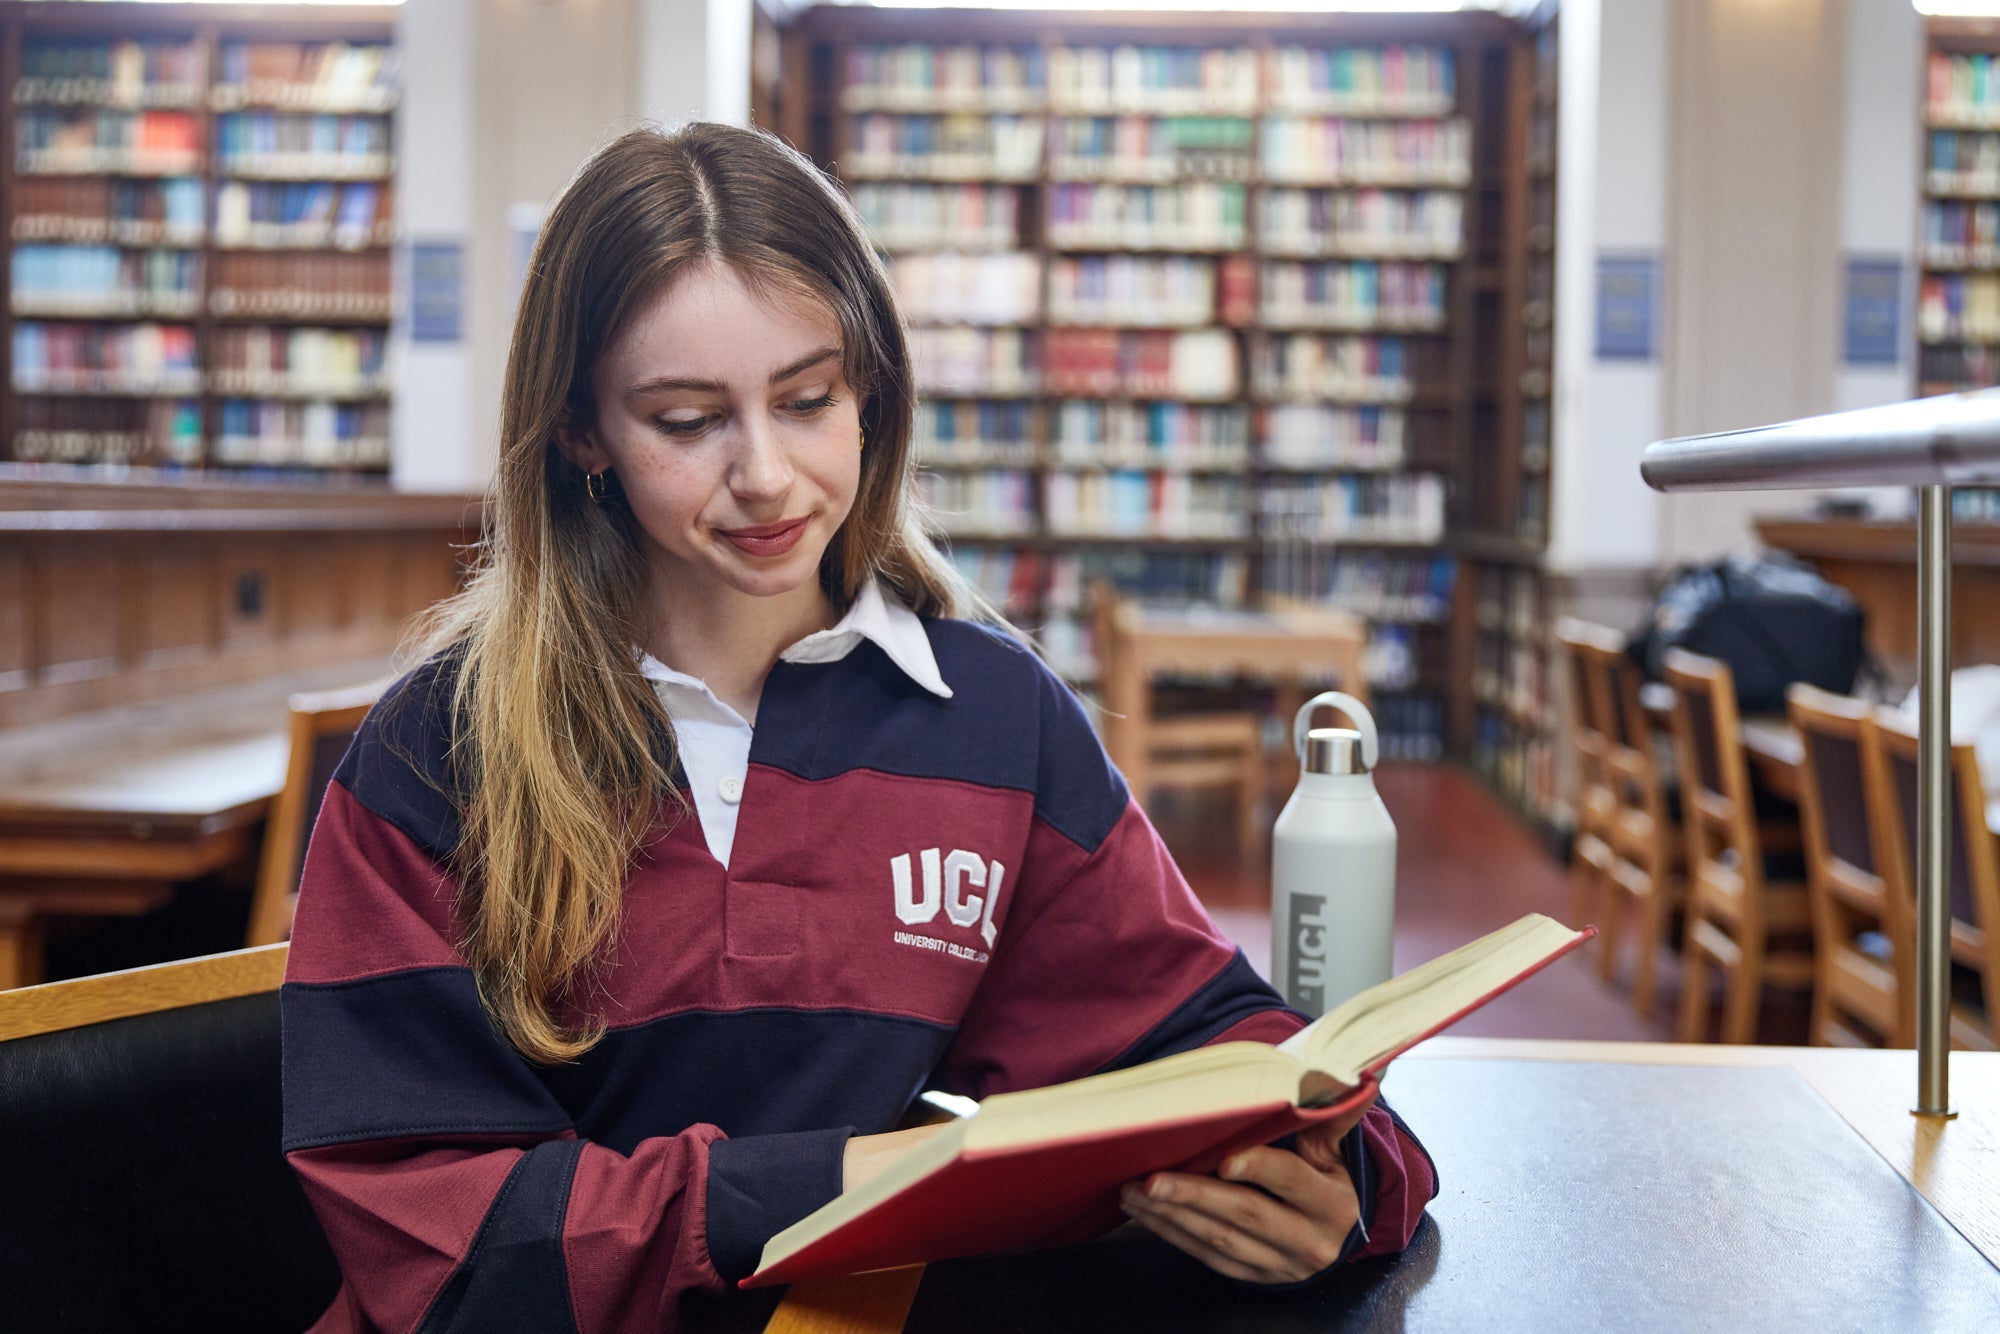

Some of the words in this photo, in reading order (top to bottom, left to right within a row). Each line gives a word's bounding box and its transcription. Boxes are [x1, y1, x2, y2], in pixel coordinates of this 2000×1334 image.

[890, 847, 1005, 950] UCL
[894, 931, 949, 953] UNIVERSITY
[1298, 903, 1327, 987] UCL
